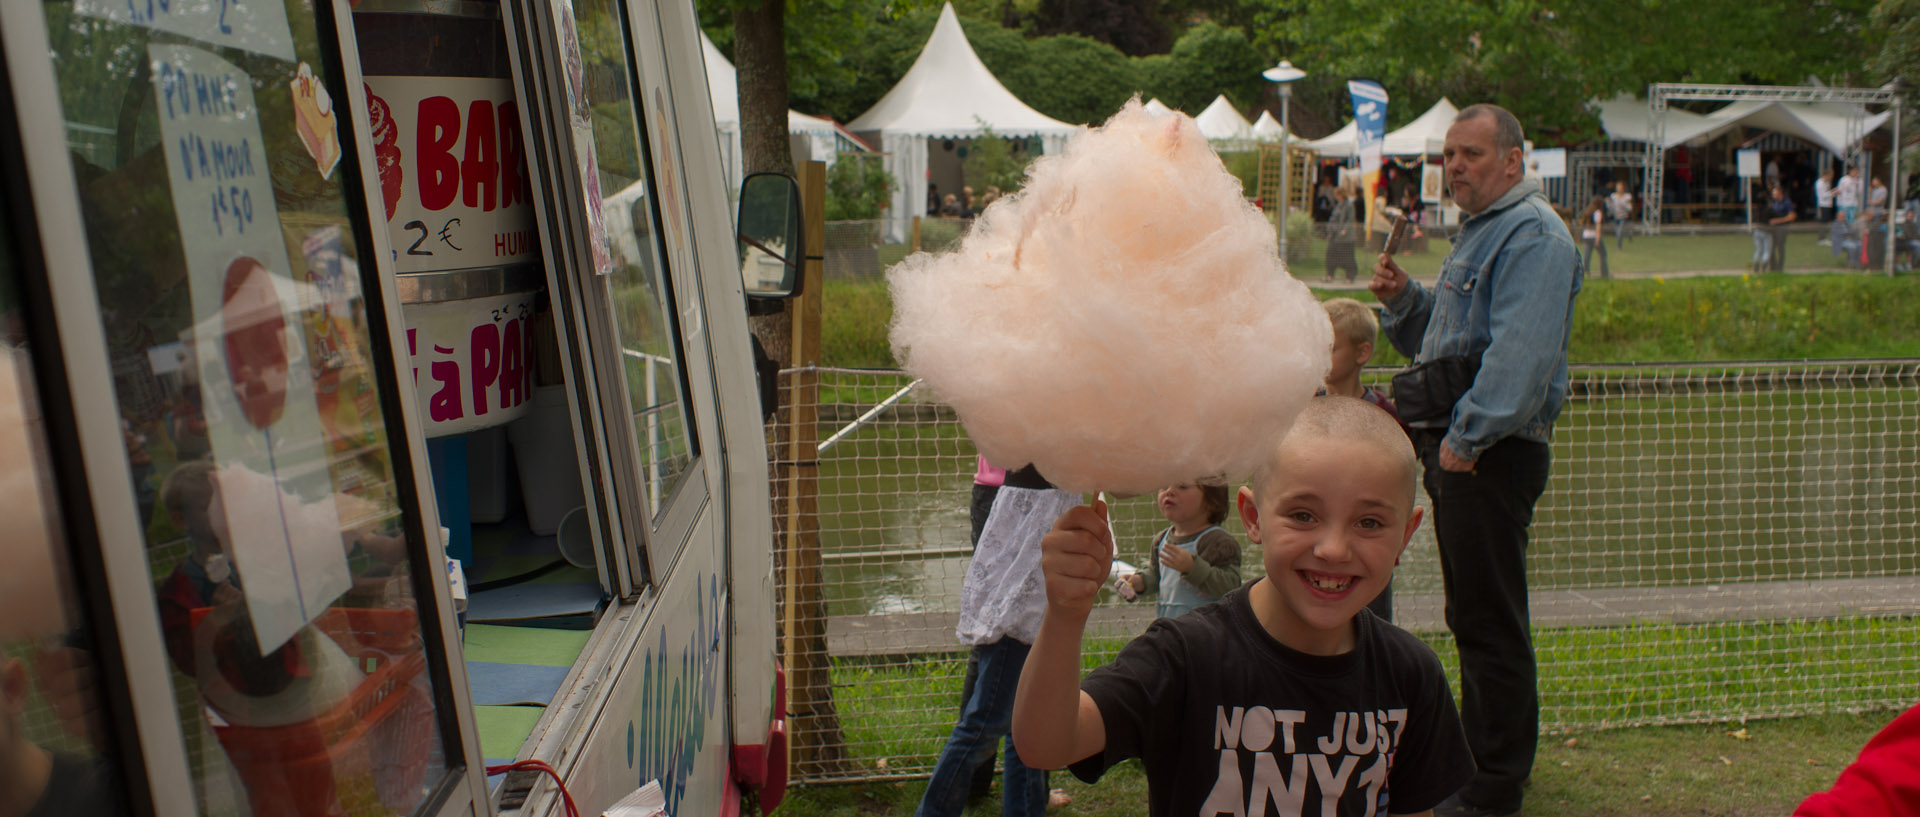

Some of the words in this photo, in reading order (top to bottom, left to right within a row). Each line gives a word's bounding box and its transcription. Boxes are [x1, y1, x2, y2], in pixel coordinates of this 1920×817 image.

[430, 344, 464, 422] à
[1214, 705, 1306, 754] NOT
[1317, 708, 1408, 755] JUST
